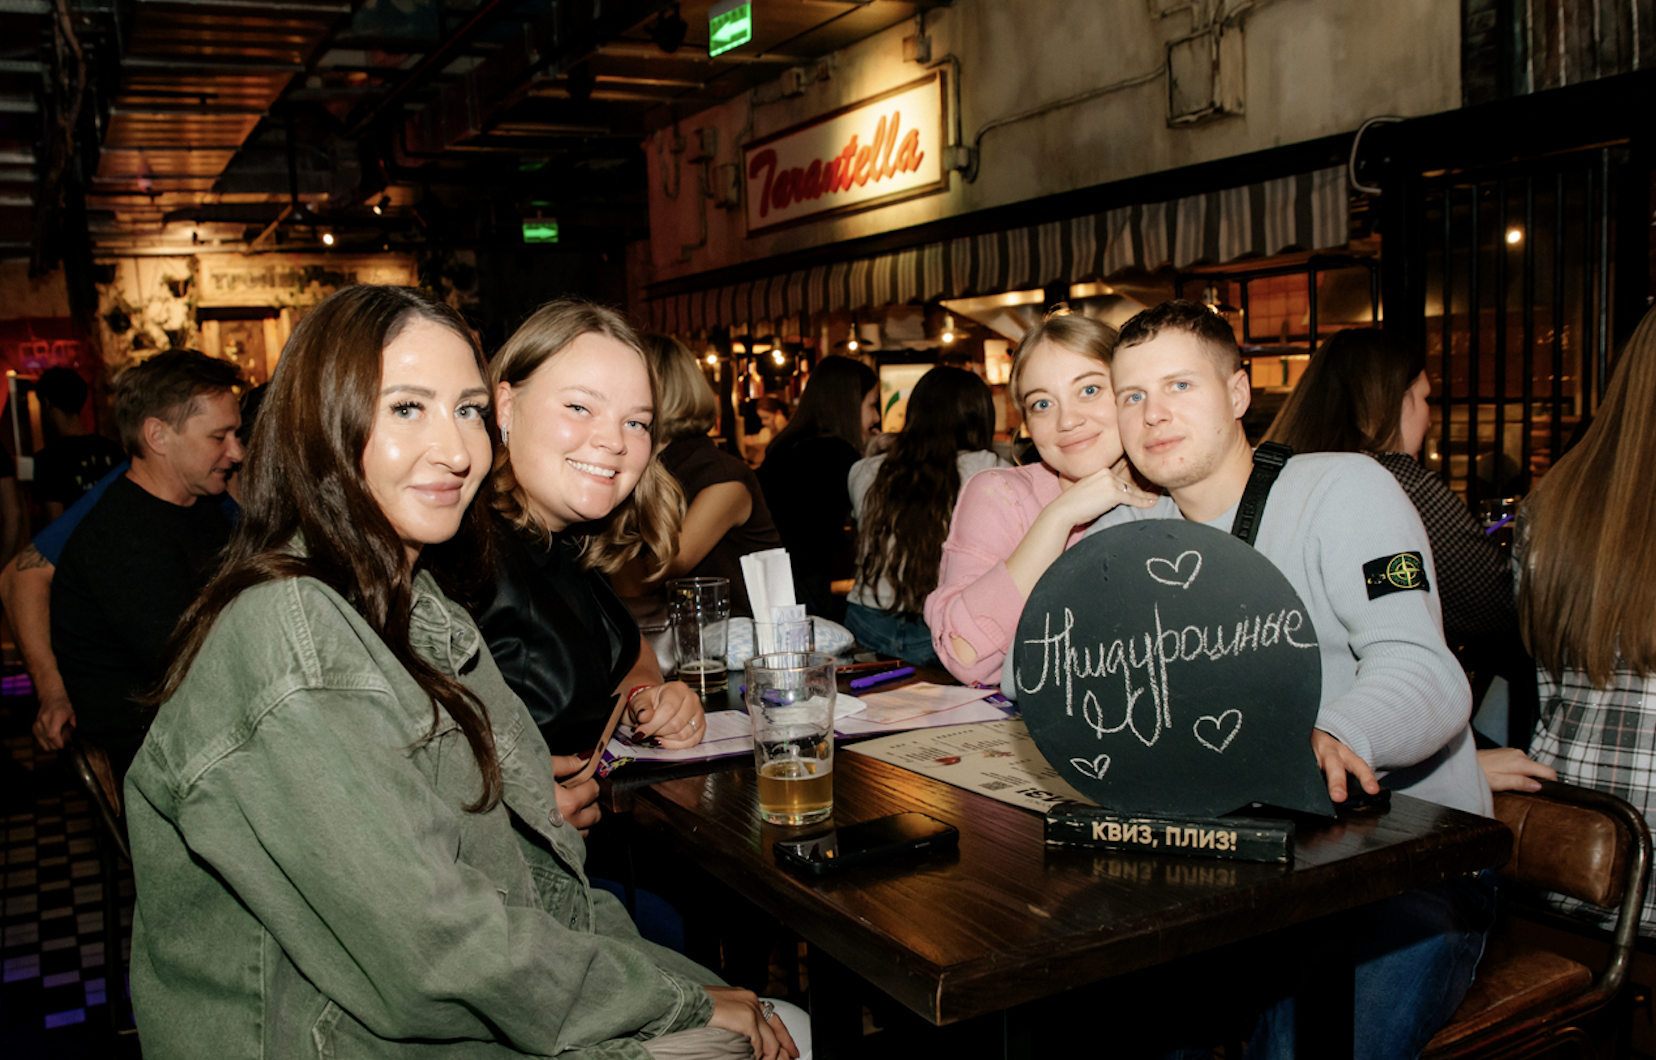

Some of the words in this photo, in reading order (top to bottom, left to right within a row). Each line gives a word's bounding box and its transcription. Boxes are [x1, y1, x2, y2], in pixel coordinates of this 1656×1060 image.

[749, 110, 925, 219] Tarantella
[1091, 821, 1159, 848] КВИЗ,
[1165, 826, 1238, 851] ПЛИЗ!
